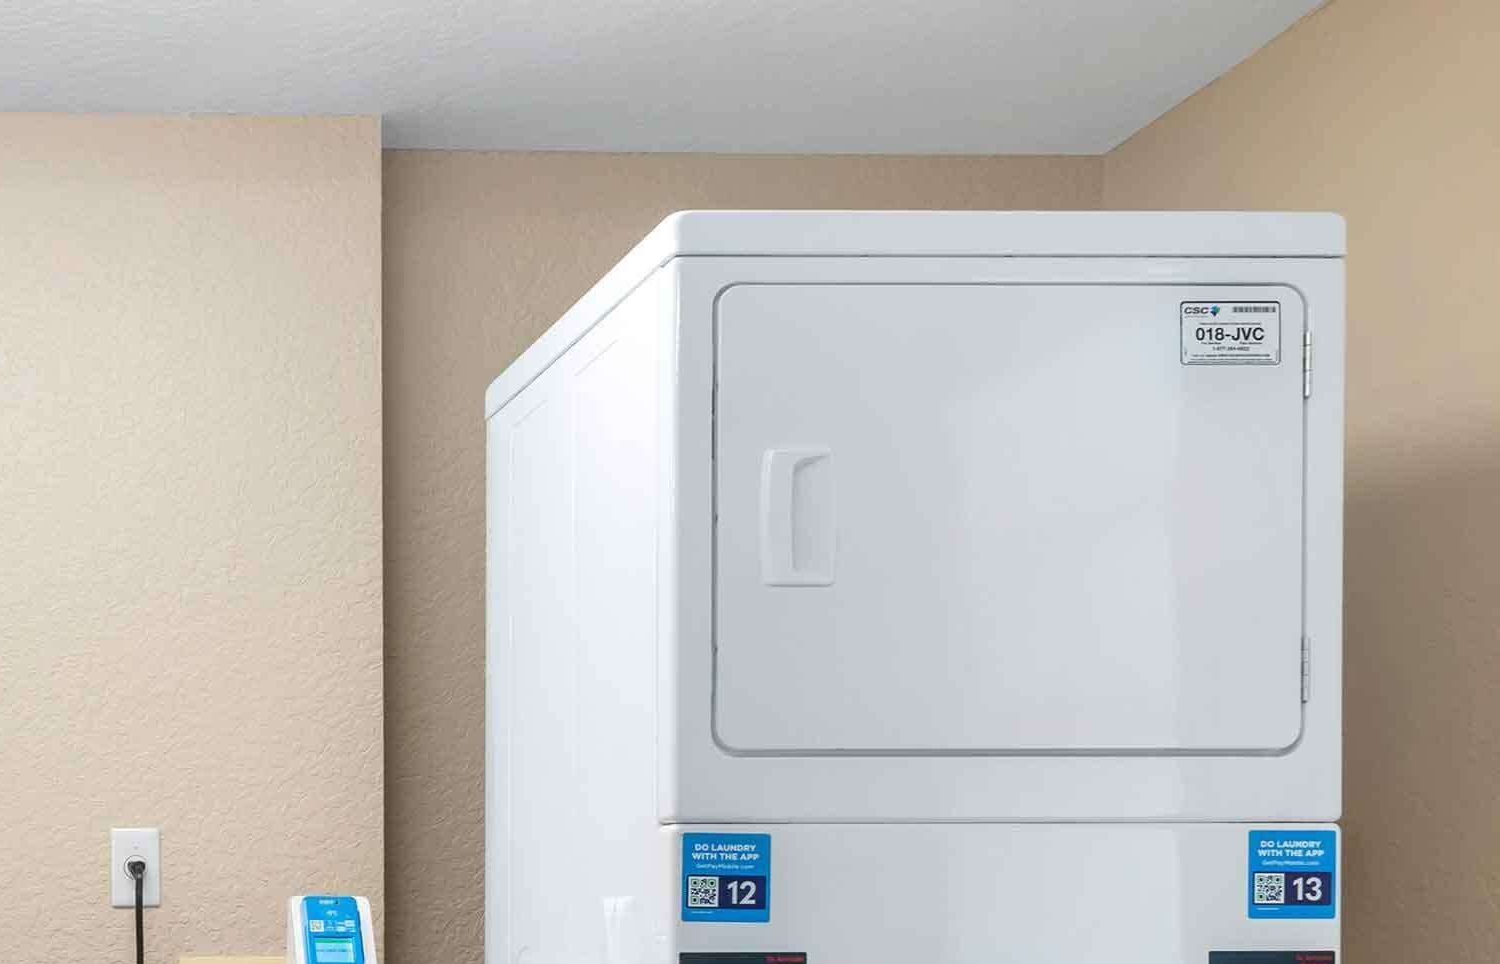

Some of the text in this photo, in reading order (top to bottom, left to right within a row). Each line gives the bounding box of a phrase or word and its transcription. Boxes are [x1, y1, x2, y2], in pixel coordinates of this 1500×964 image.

[1184, 306, 1209, 315] CSC
[1195, 327, 1265, 341] 018-JVC
[694, 843, 757, 852] DO LAUNDRY
[1260, 840, 1322, 848] DO LAUNDRY
[691, 852, 717, 860] WITH
[719, 852, 738, 860] THE
[1257, 849, 1325, 857] WITH THE APP
[726, 880, 757, 905] 12
[1292, 876, 1323, 902] 13
